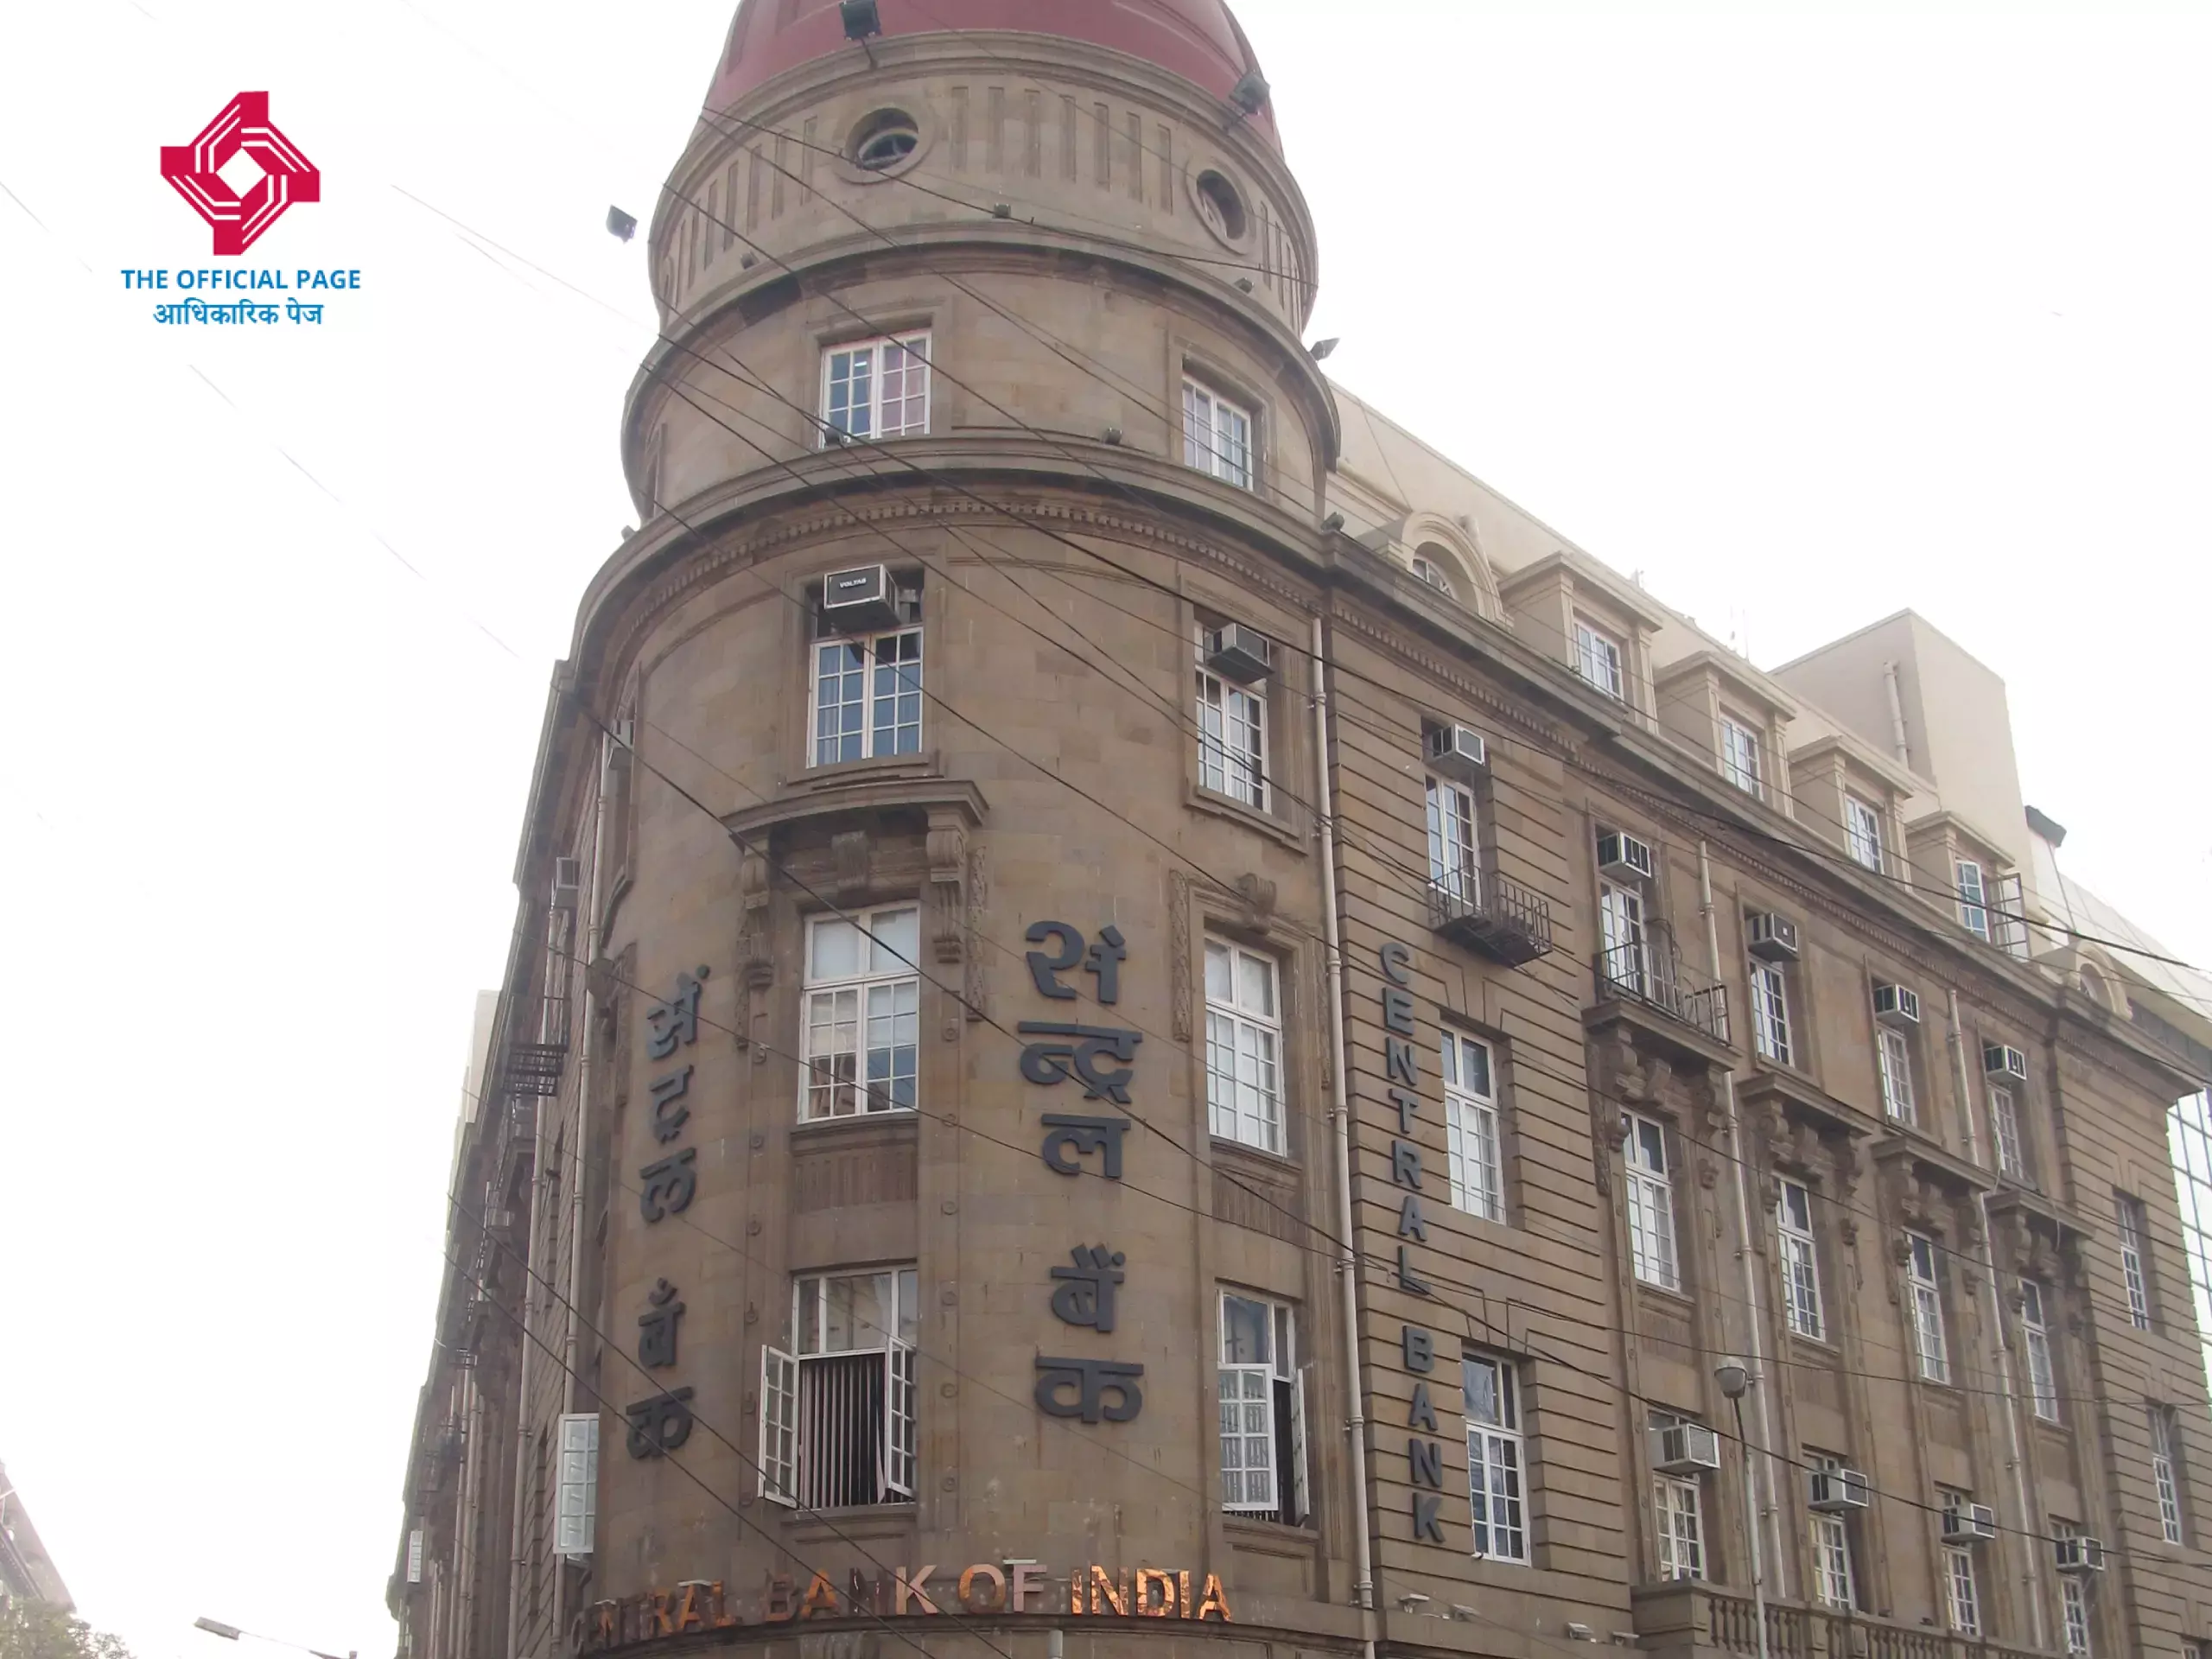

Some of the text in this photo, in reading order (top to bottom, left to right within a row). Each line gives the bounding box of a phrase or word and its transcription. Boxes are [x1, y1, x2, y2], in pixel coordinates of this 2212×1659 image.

[1380, 942, 1446, 1543] CENTRAL BANK
[1035, 1243, 1144, 1424] बैंक
[764, 1565, 939, 1621] BANK
[958, 1563, 1047, 1614] OF
[1071, 1564, 1232, 1623] INDIA
